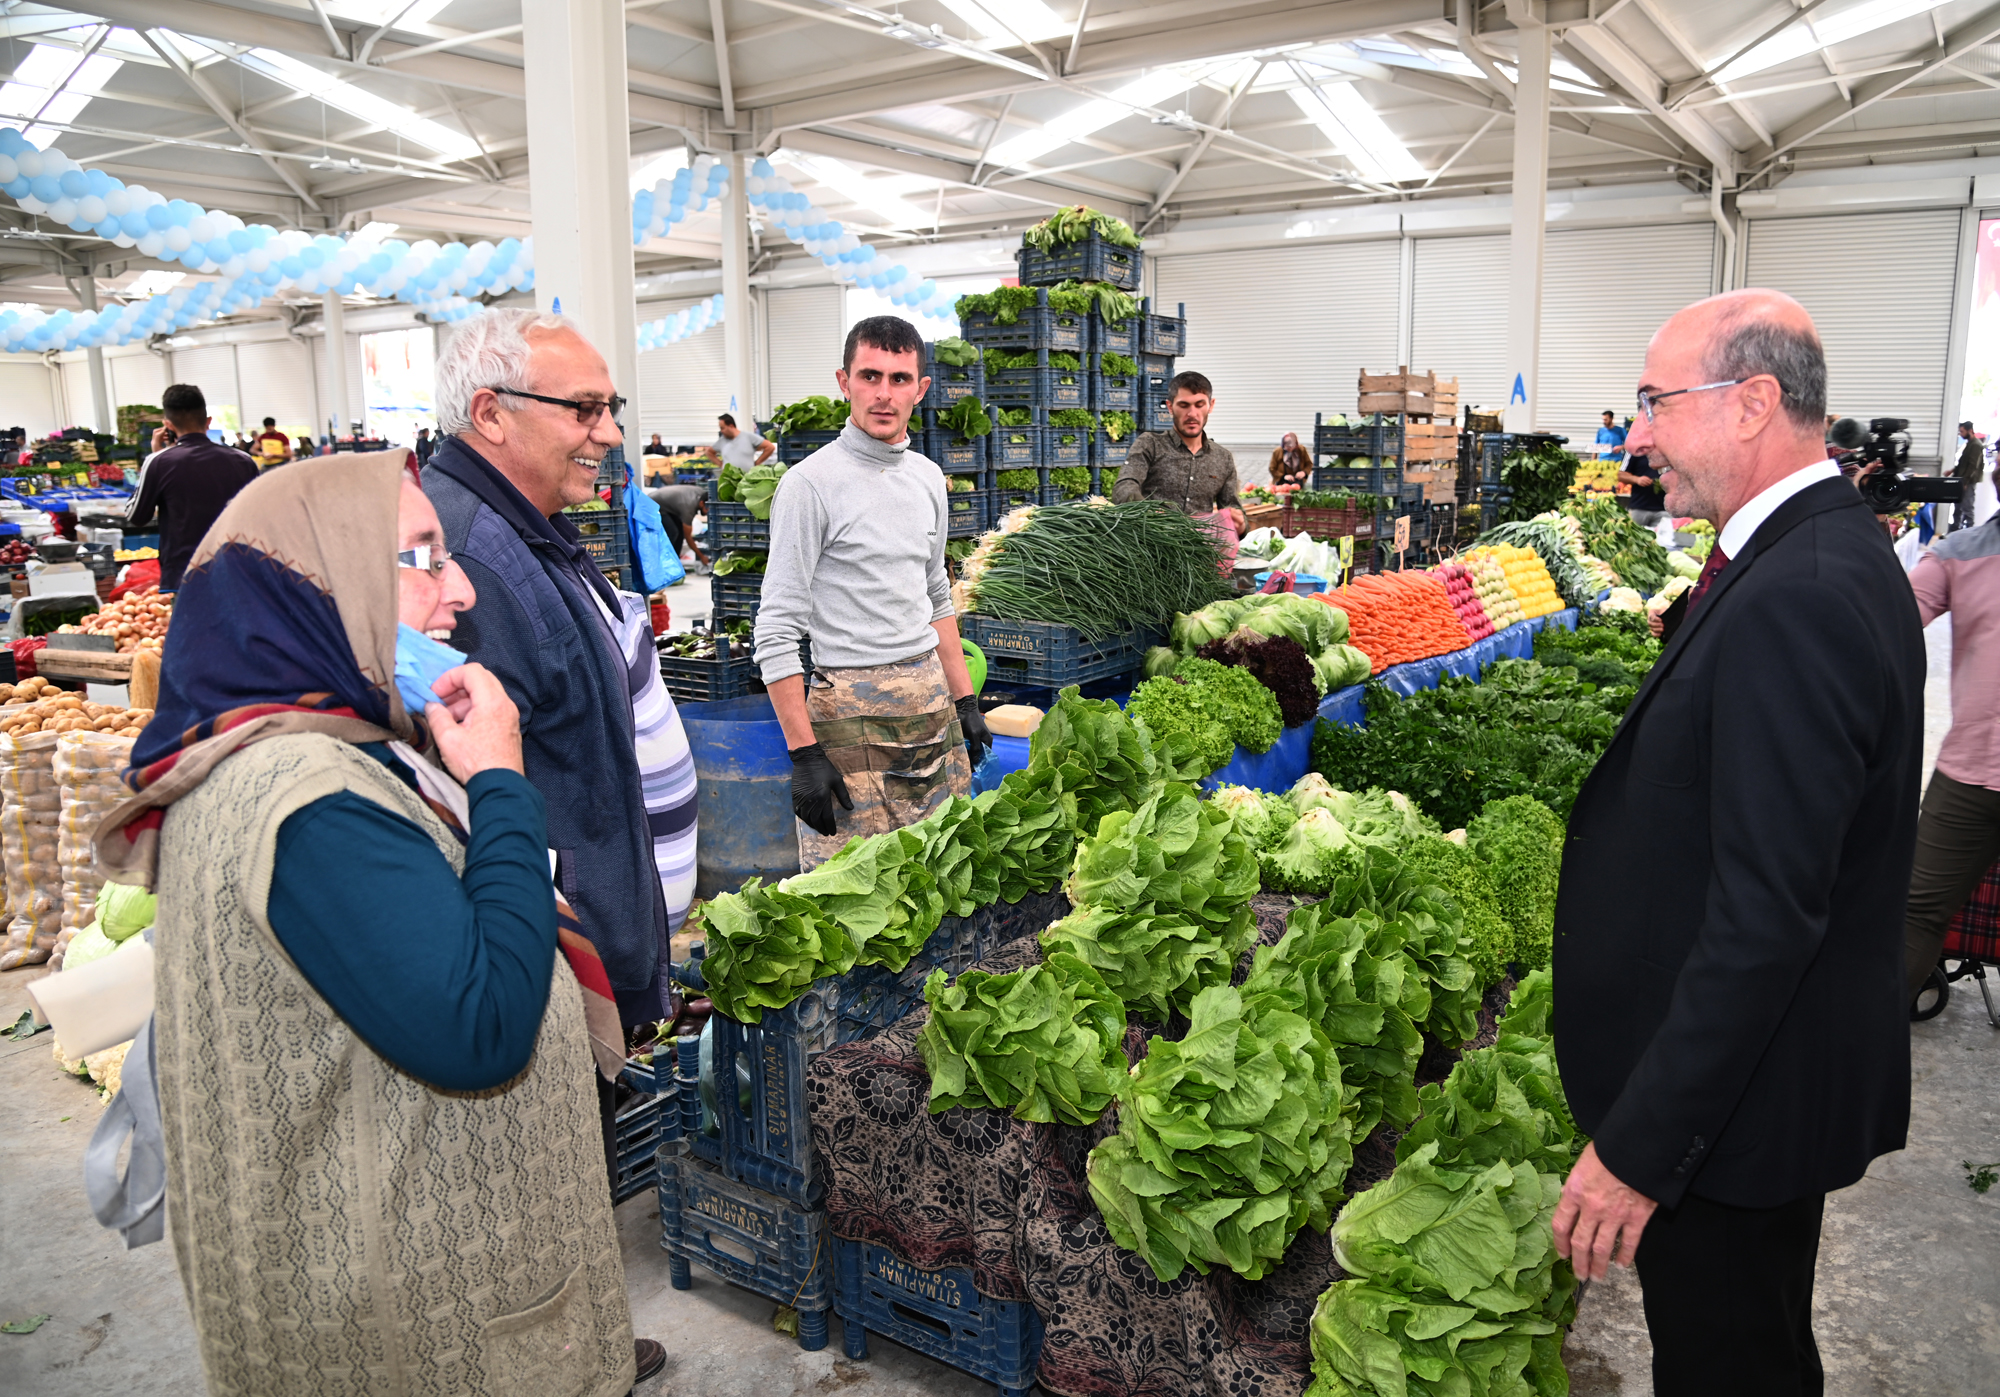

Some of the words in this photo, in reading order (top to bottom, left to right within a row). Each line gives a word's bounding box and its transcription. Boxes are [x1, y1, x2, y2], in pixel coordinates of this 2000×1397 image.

[729, 394, 738, 411] A
[1510, 371, 1527, 406] A
[988, 637, 1033, 650] SITMAPINAR
[765, 1045, 780, 1136] SITMAPINAR
[879, 1263, 962, 1306] SITMAPINAR
